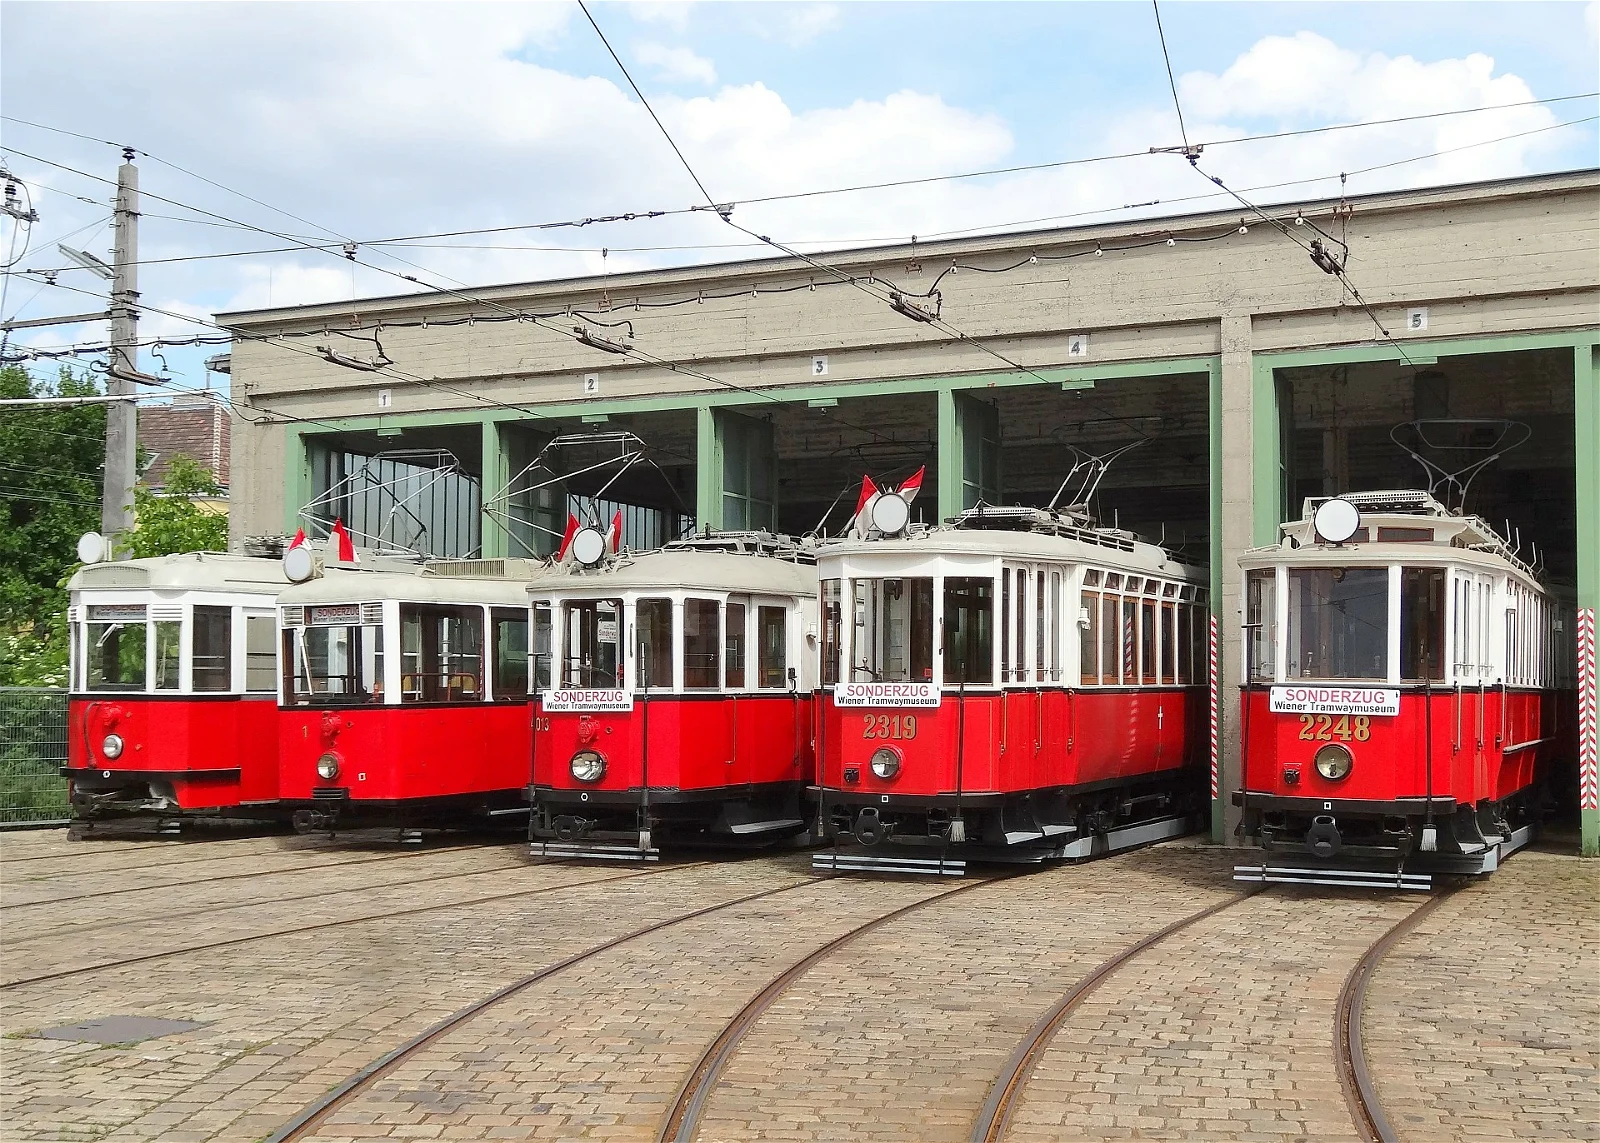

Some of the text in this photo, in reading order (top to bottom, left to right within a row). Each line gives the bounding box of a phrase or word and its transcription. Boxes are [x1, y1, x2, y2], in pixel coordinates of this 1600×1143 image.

[1412, 313, 1421, 327] 5
[1071, 341, 1080, 354] 4
[816, 360, 823, 373] 3
[588, 378, 594, 390] 2
[382, 394, 386, 405] 1
[553, 691, 623, 702] SONDERZUG
[847, 685, 929, 697] SONDERZUG
[1285, 689, 1385, 704] SONDERZUG
[546, 702, 630, 711] Wiener Tramwaymuseum
[838, 696, 937, 706] Wiener Tramwaymuseum
[1274, 701, 1396, 713] Wiener Tramwaymuseum
[863, 714, 917, 740] 2319
[1299, 714, 1371, 741] 2248
